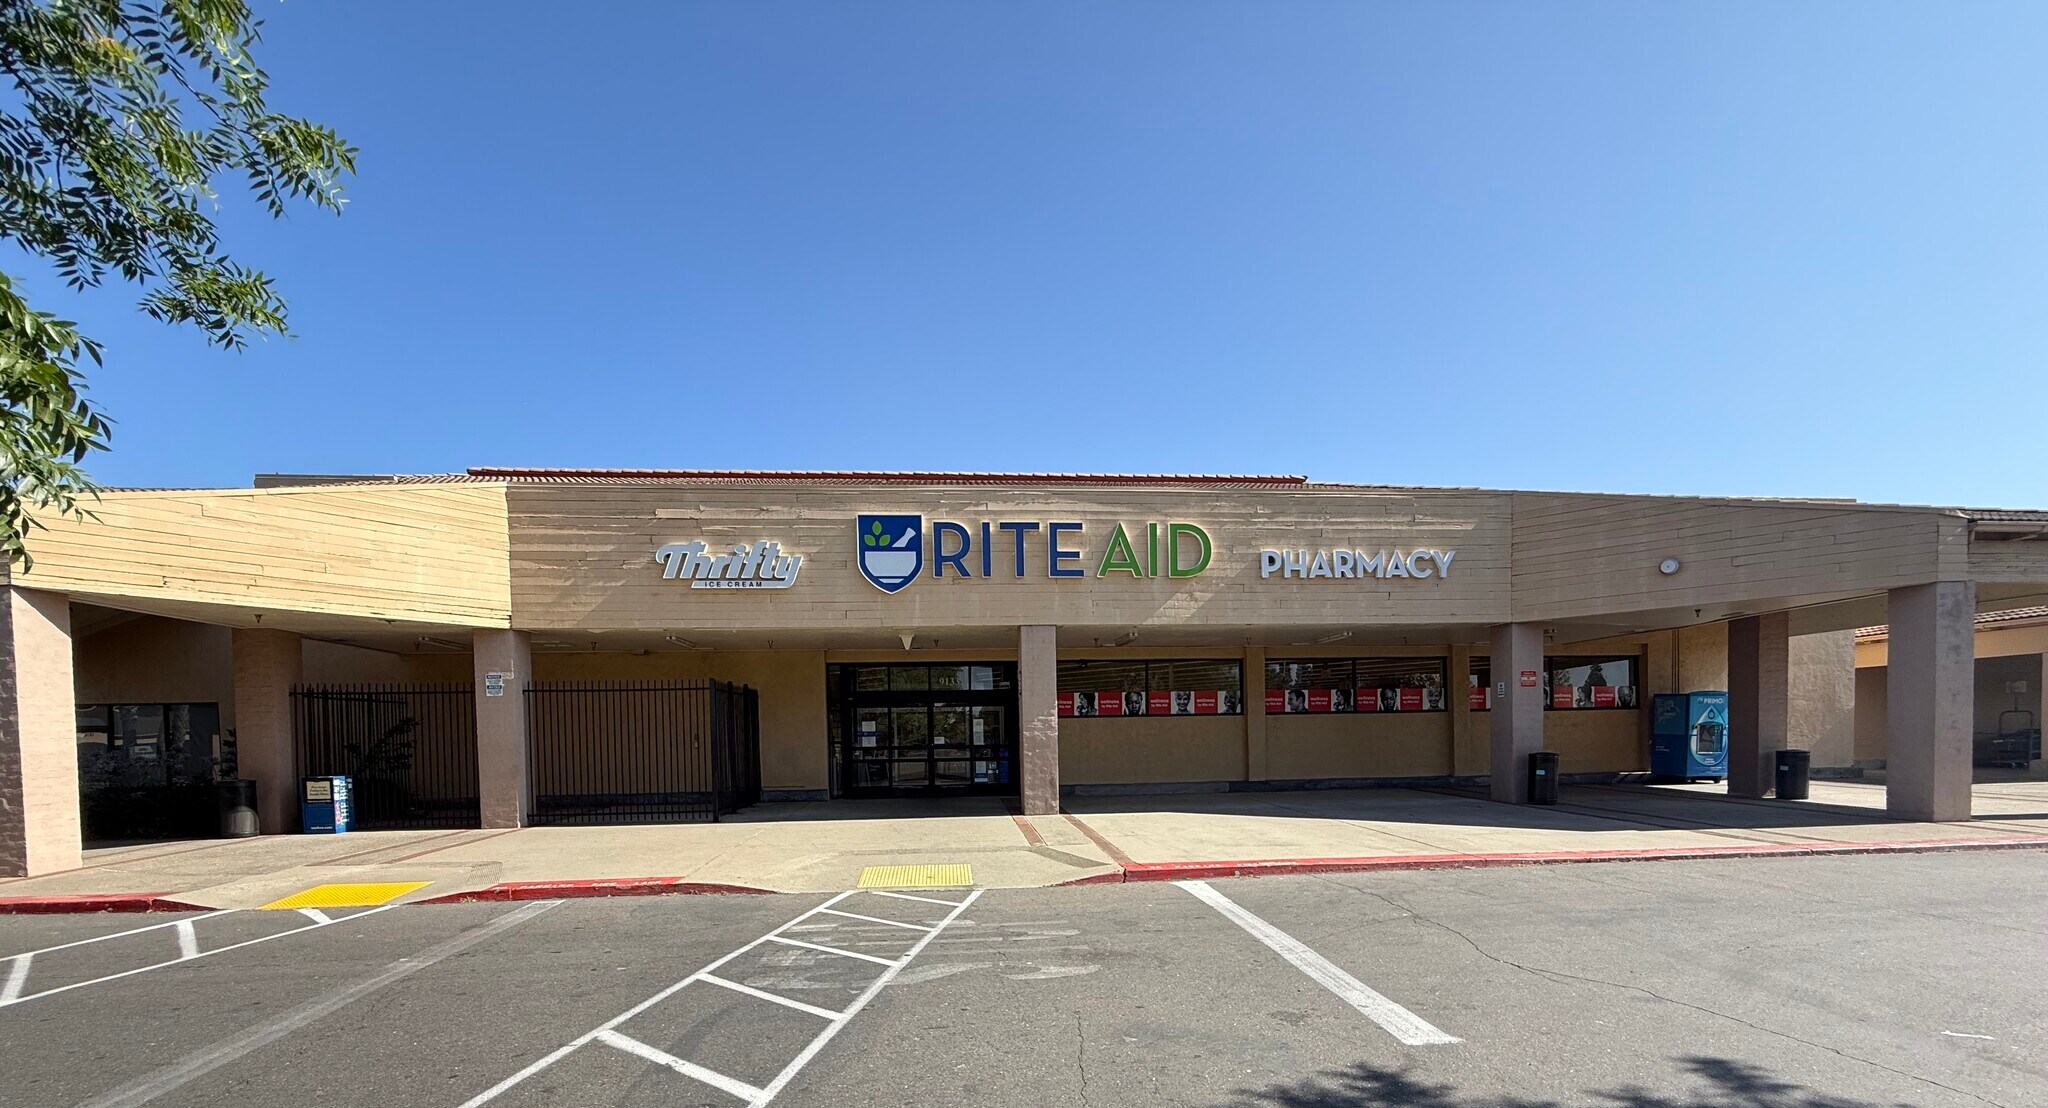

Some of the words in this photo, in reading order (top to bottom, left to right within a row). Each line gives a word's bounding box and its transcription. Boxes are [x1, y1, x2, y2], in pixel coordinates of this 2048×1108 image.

[655, 540, 803, 588] Thrifty
[932, 521, 1085, 579] RITE
[1097, 521, 1213, 579] AID
[1260, 549, 1456, 578] PHARMACY
